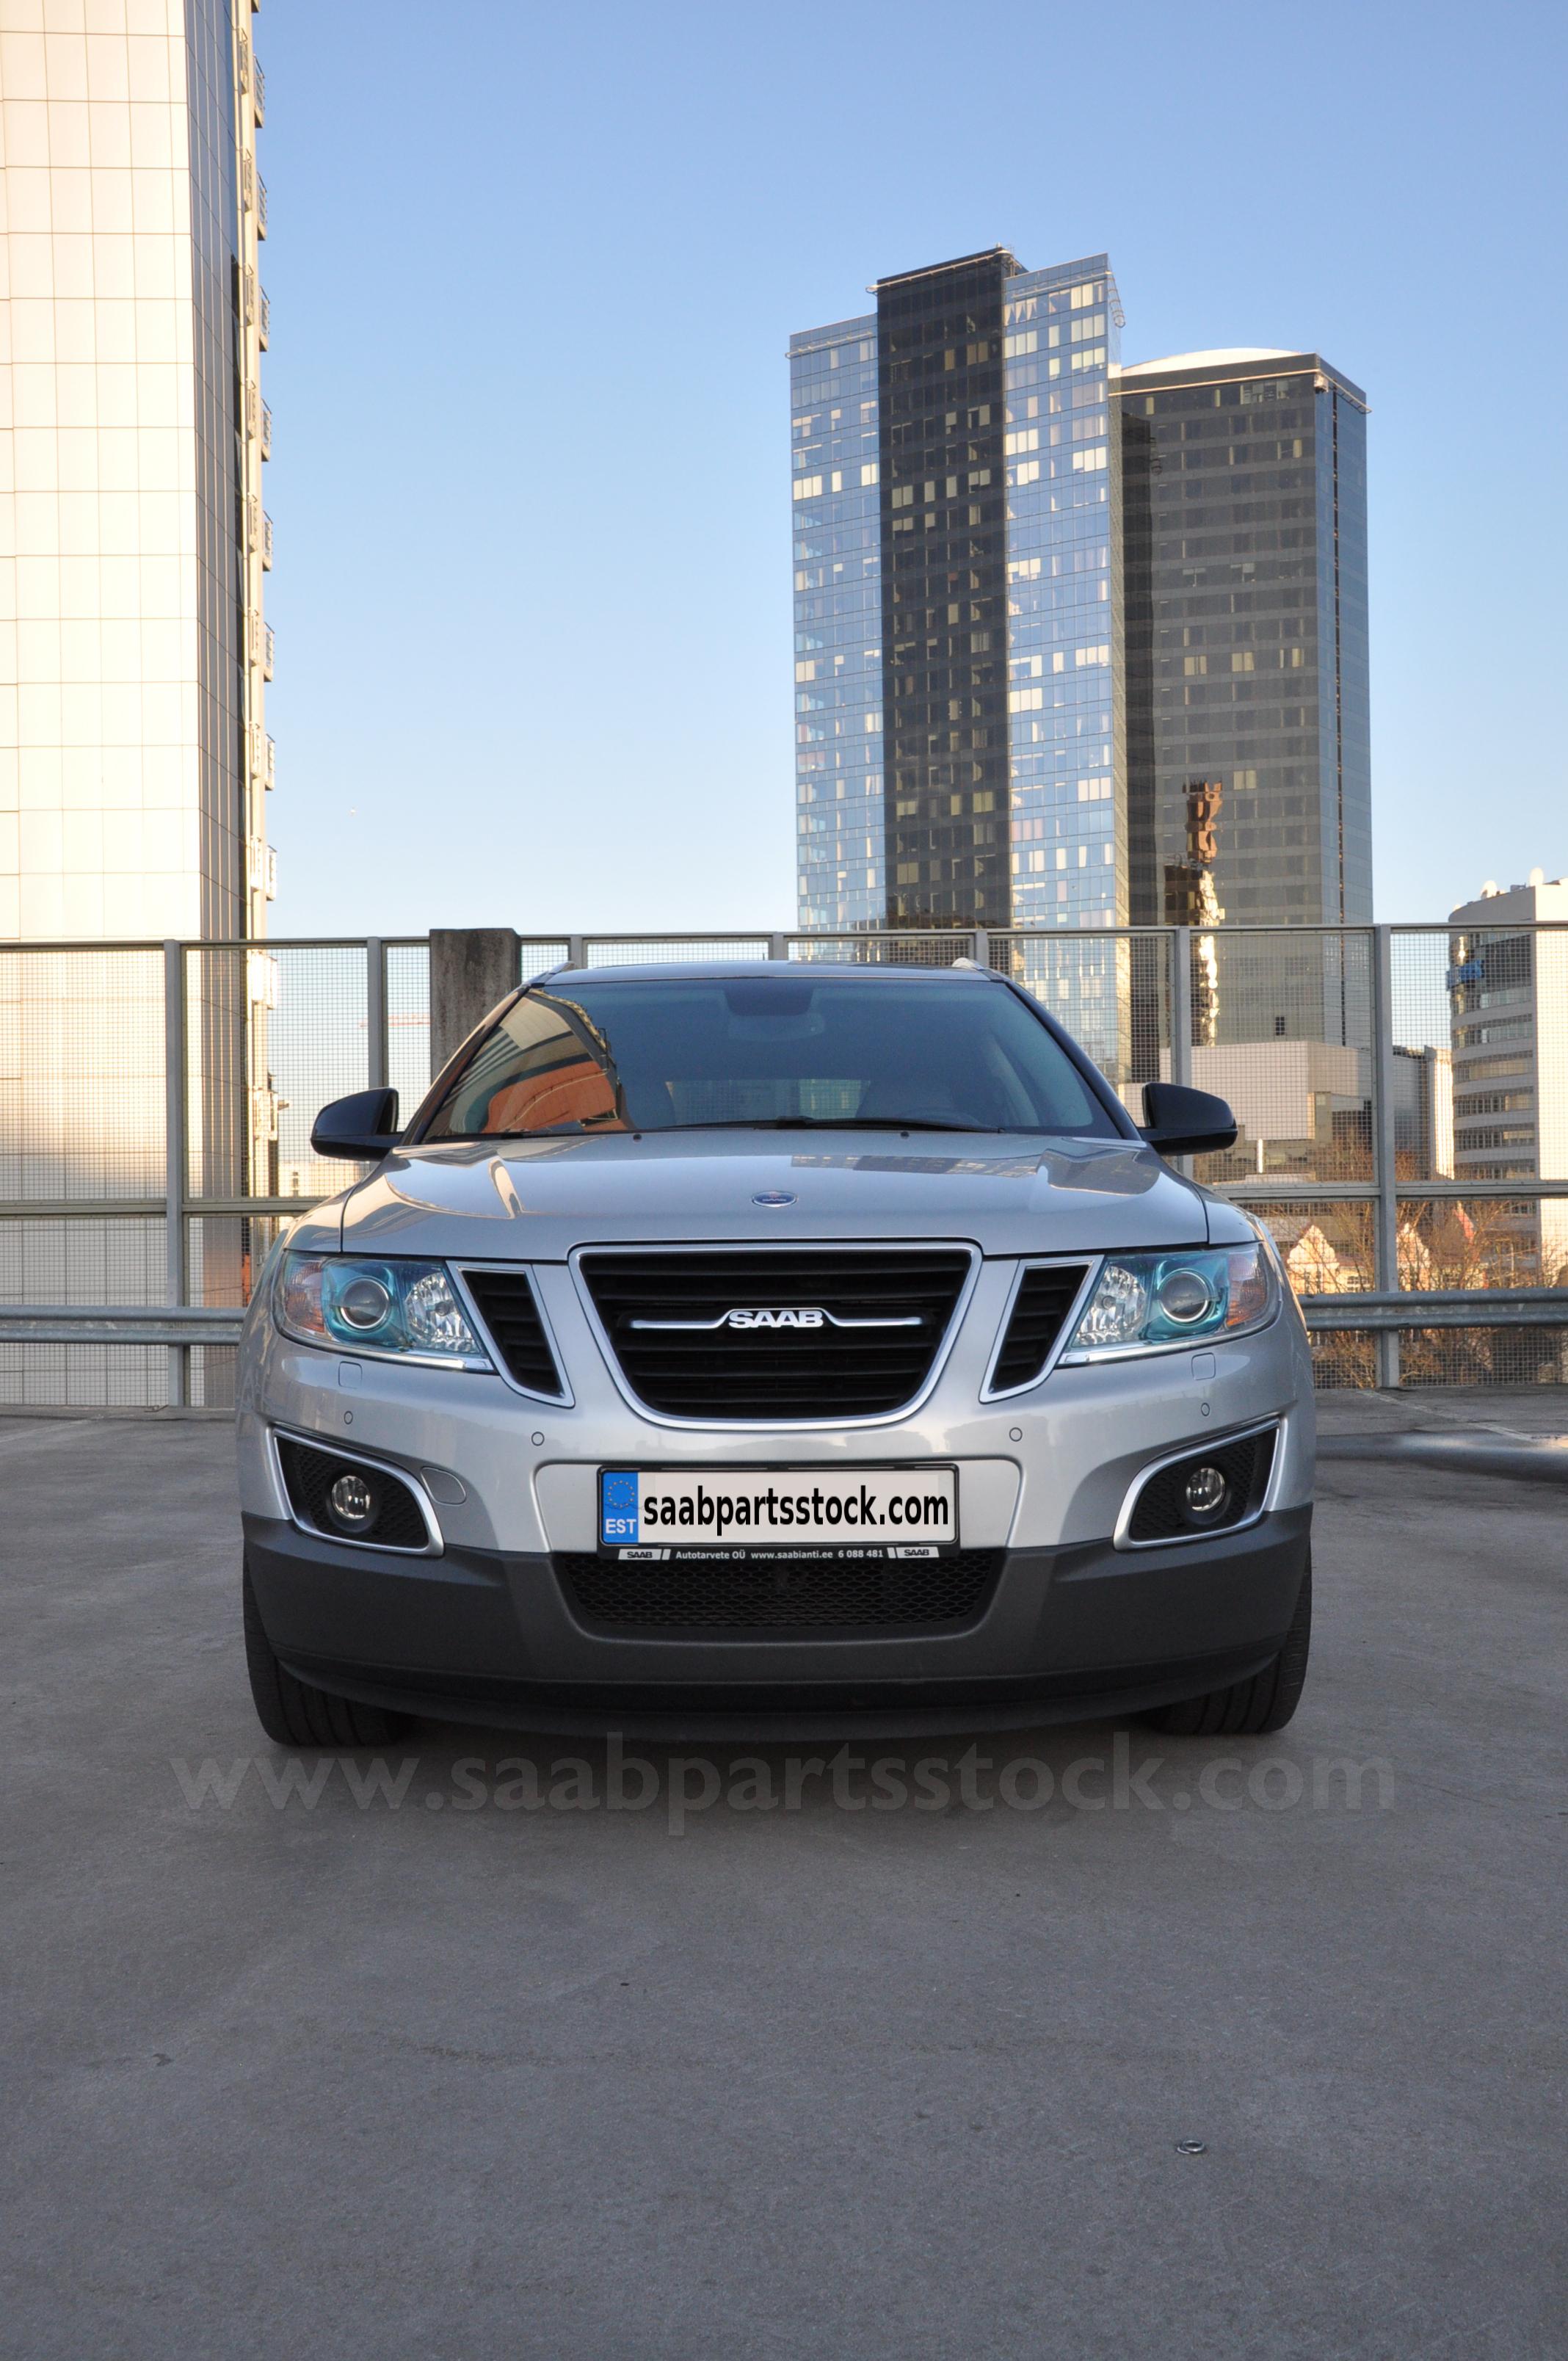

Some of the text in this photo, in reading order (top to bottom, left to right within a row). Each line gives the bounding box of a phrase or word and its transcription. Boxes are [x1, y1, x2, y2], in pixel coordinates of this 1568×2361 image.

[728, 1310, 824, 1328] SAAB
[643, 1485, 949, 1537] saabpartsstock.com
[605, 1518, 636, 1534] EST
[675, 1549, 883, 1559] Autotarvete OÜ www.saabianti.ee 6 088 481
